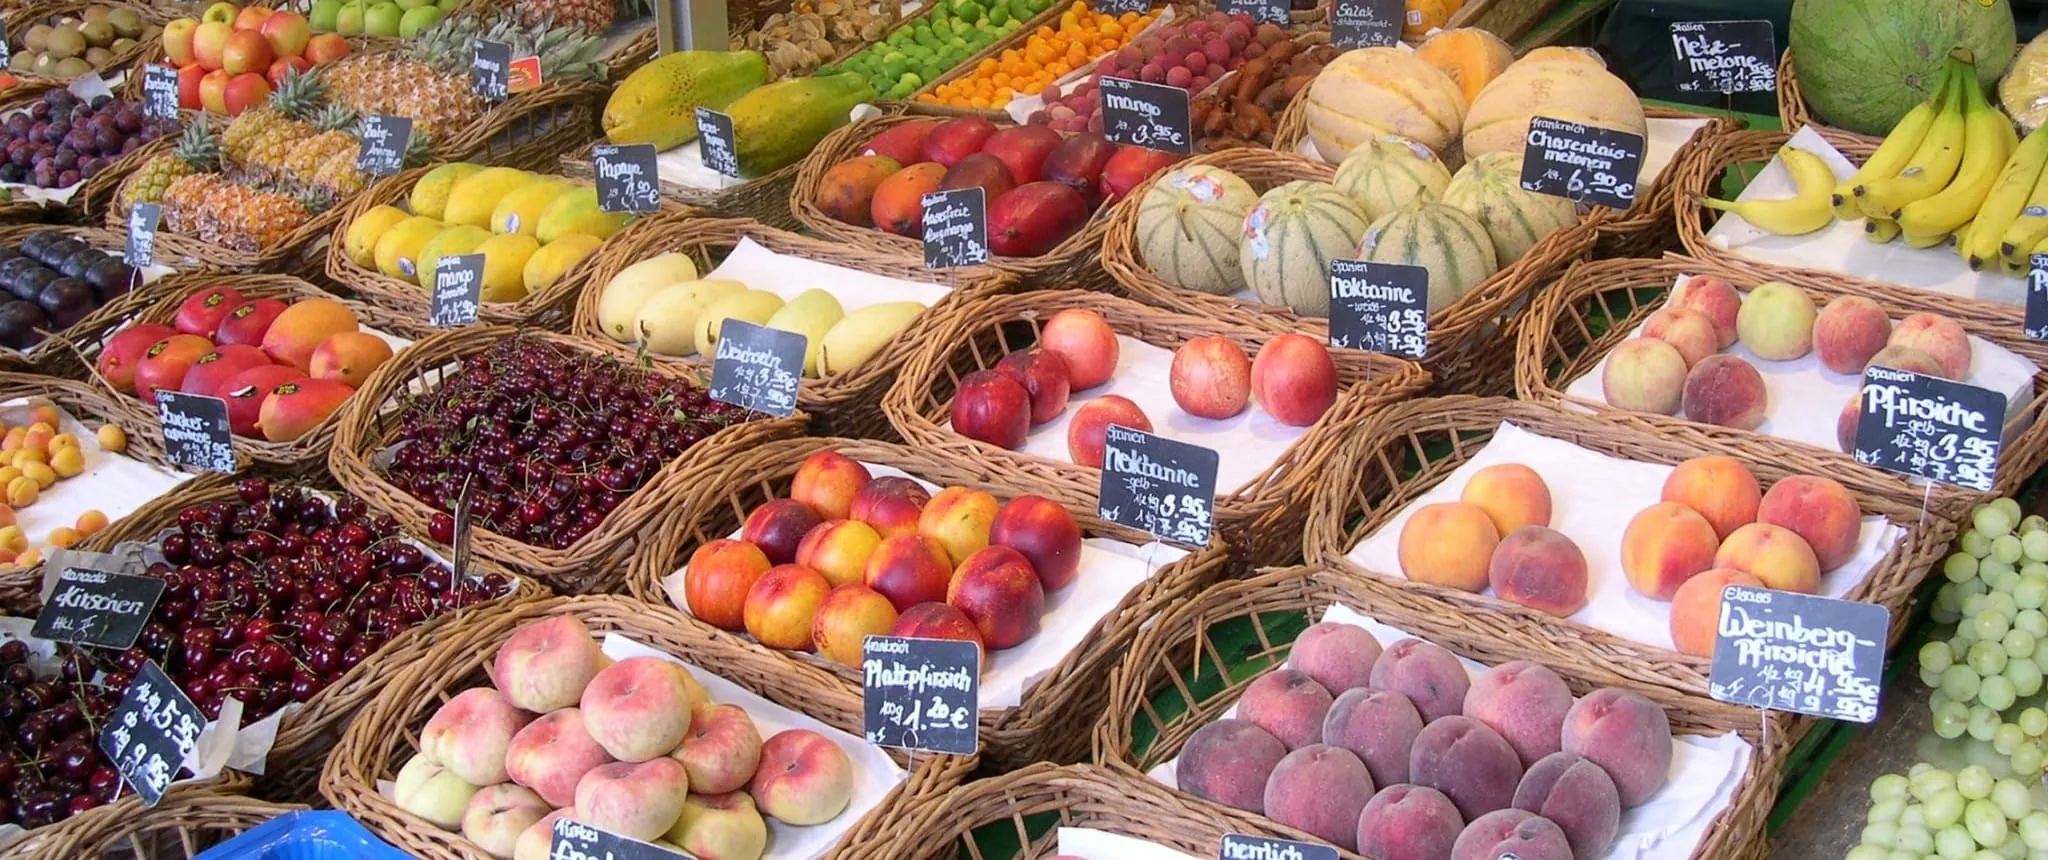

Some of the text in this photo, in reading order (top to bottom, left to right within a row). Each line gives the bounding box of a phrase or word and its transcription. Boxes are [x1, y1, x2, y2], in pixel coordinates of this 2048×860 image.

[1866, 367, 1915, 382] Spanien
[1862, 384, 1988, 433] Pfirsiche
[56, 585, 144, 615] Kirschen
